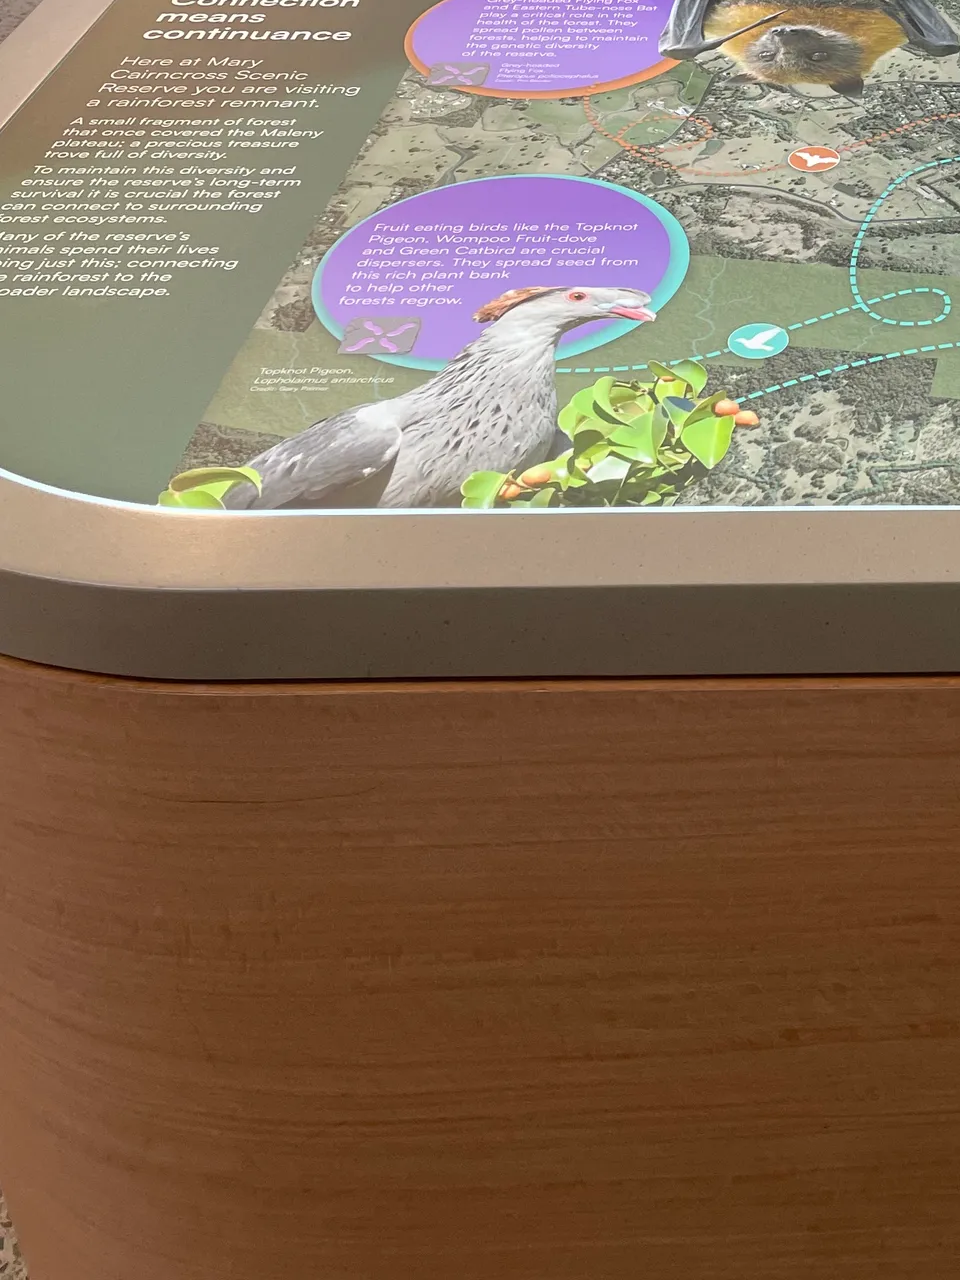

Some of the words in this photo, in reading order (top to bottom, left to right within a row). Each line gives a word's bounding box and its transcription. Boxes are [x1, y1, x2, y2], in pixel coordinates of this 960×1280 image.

[157, 13, 265, 23] means
[144, 28, 351, 40] continuance
[120, 56, 173, 66] Here
[179, 58, 202, 66] at
[207, 57, 263, 67] Mary
[111, 70, 228, 80] Cairncross
[235, 70, 308, 80] Scenic
[98, 83, 187, 93] Reserve
[191, 86, 235, 96] you
[241, 86, 277, 94] are
[286, 84, 361, 96] visiting
[86, 99, 101, 107] a
[108, 97, 215, 108] rainforest
[221, 99, 319, 108] remnant.
[69, 117, 83, 125] A
[89, 117, 137, 125] small
[139, 117, 220, 127] fragment
[224, 117, 244, 126] of
[246, 118, 297, 126] forest
[63, 128, 98, 136] that
[151, 129, 224, 137] covered
[227, 129, 255, 137] the
[260, 129, 324, 138] Maleny
[95, 150, 124, 159] full
[127, 150, 148, 159] of
[151, 150, 227, 160] diversity.
[34, 165, 53, 174] To
[58, 165, 136, 174] maintain
[143, 165, 175, 175] this
[180, 166, 256, 176] diversity
[260, 166, 296, 175] and
[89, 177, 119, 186] the
[210, 178, 301, 187] long-term
[42, 203, 120, 211] connect
[125, 202, 144, 211] to
[148, 202, 263, 213] surrounding
[374, 223, 410, 232] Fruit
[414, 224, 464, 234] eating
[469, 223, 508, 232] birds
[513, 223, 539, 231] like
[545, 223, 570, 231] the
[576, 222, 638, 232] Topknot
[351, 271, 380, 280] this
[385, 270, 416, 280] rich
[421, 271, 464, 281] plant
[469, 270, 510, 279] bank
[346, 284, 362, 293] to
[367, 283, 404, 294] help
[409, 283, 454, 292] other
